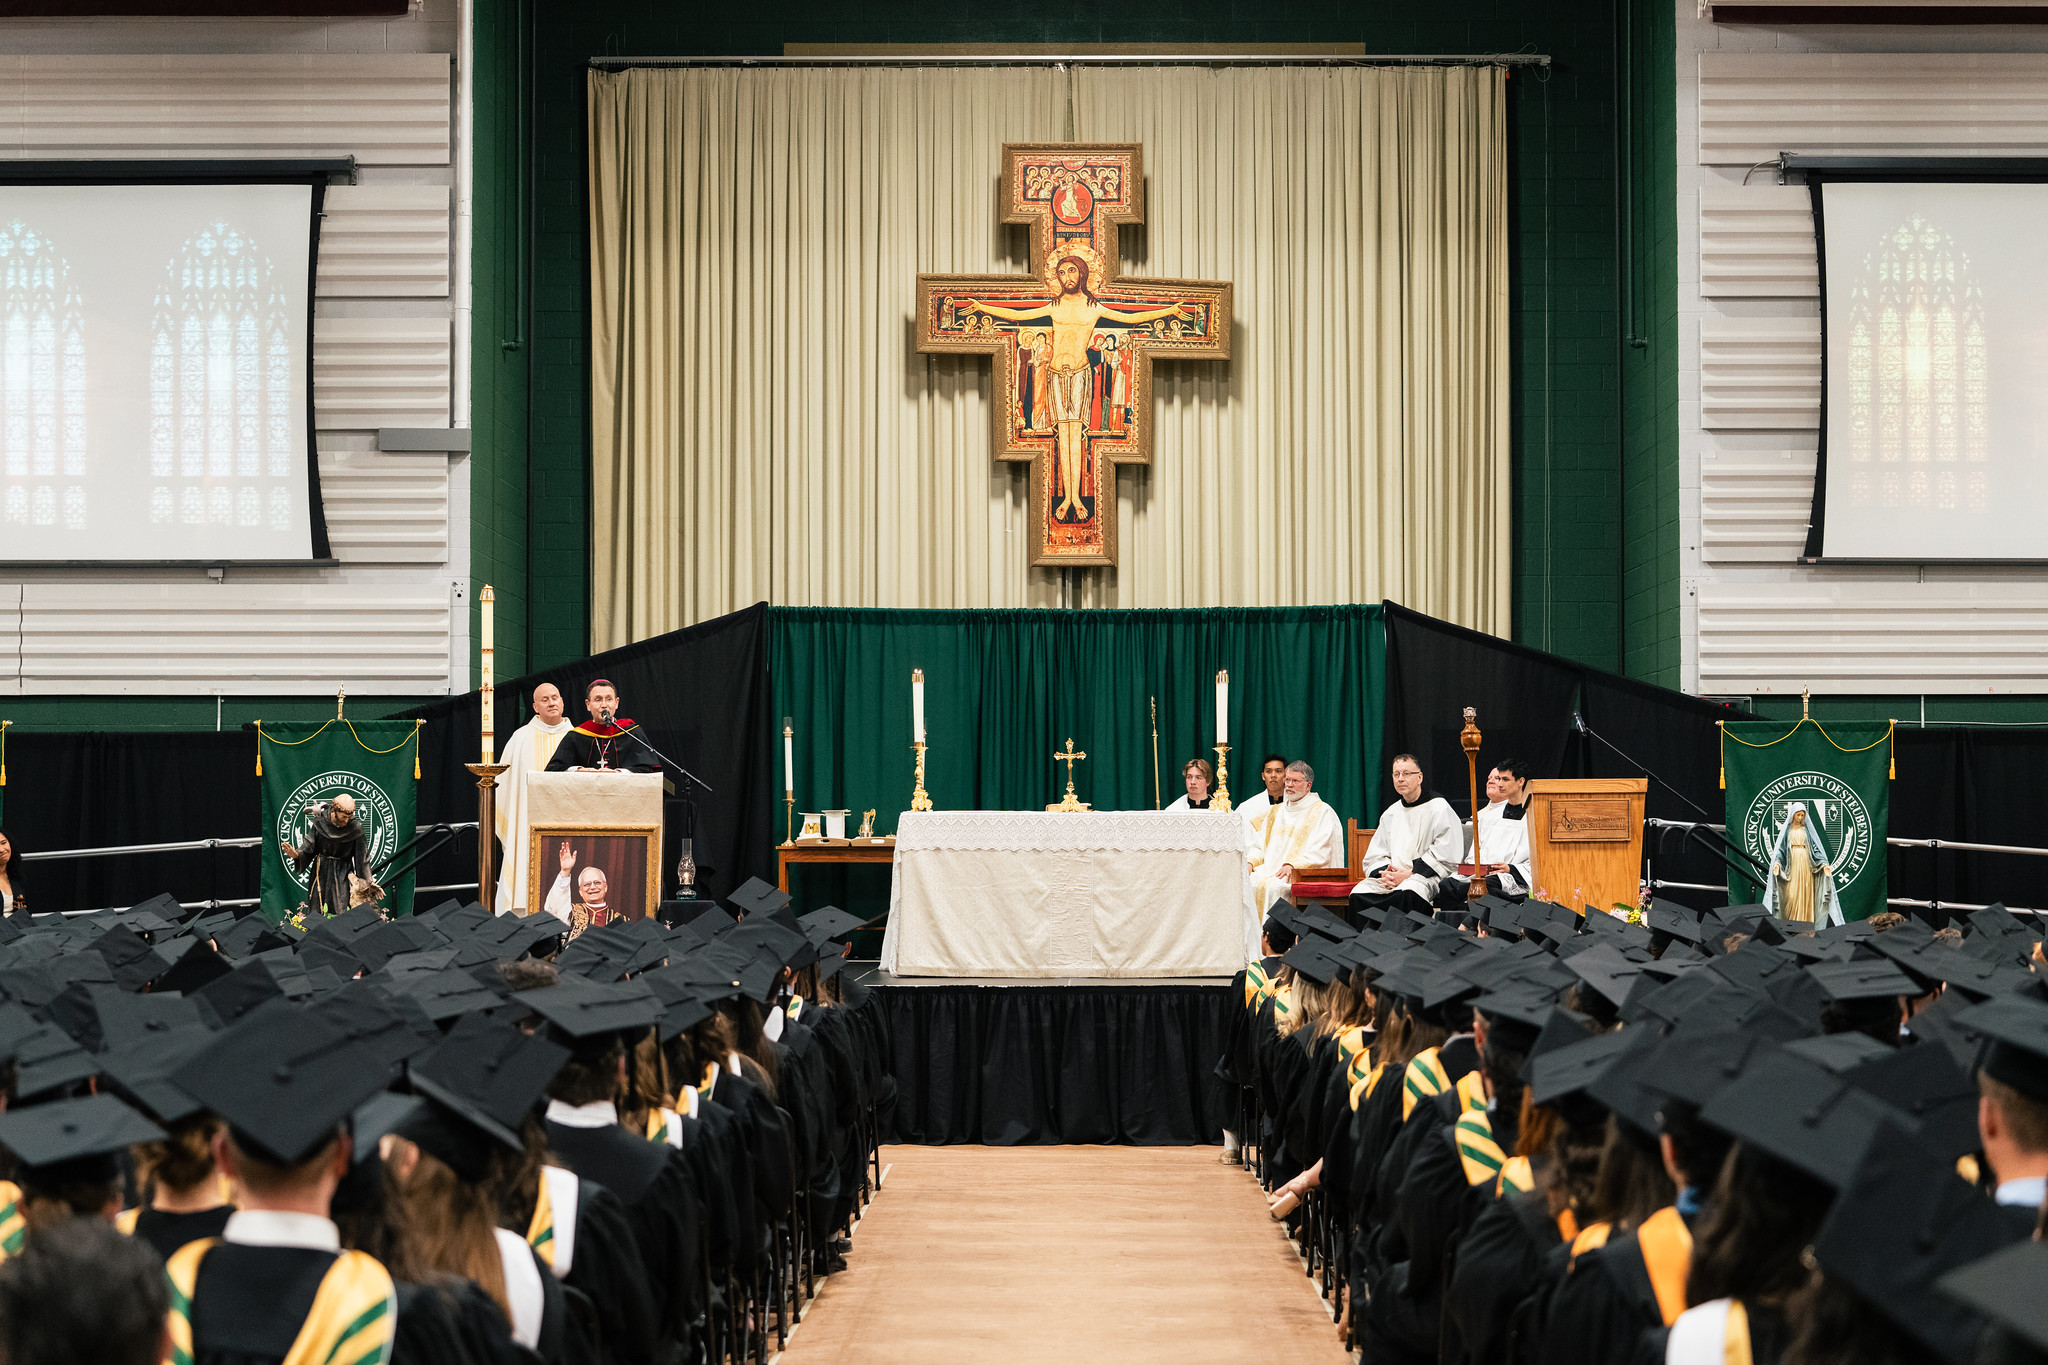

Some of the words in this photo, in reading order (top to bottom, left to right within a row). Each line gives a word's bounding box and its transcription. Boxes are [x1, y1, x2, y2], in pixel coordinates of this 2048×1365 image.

[295, 774, 359, 803] UNIVERSITY
[356, 780, 374, 797] OF
[1762, 774, 1828, 803] UNIVERSITY
[1826, 780, 1844, 795] OF
[1839, 789, 1869, 871] STEUBENVILLE
